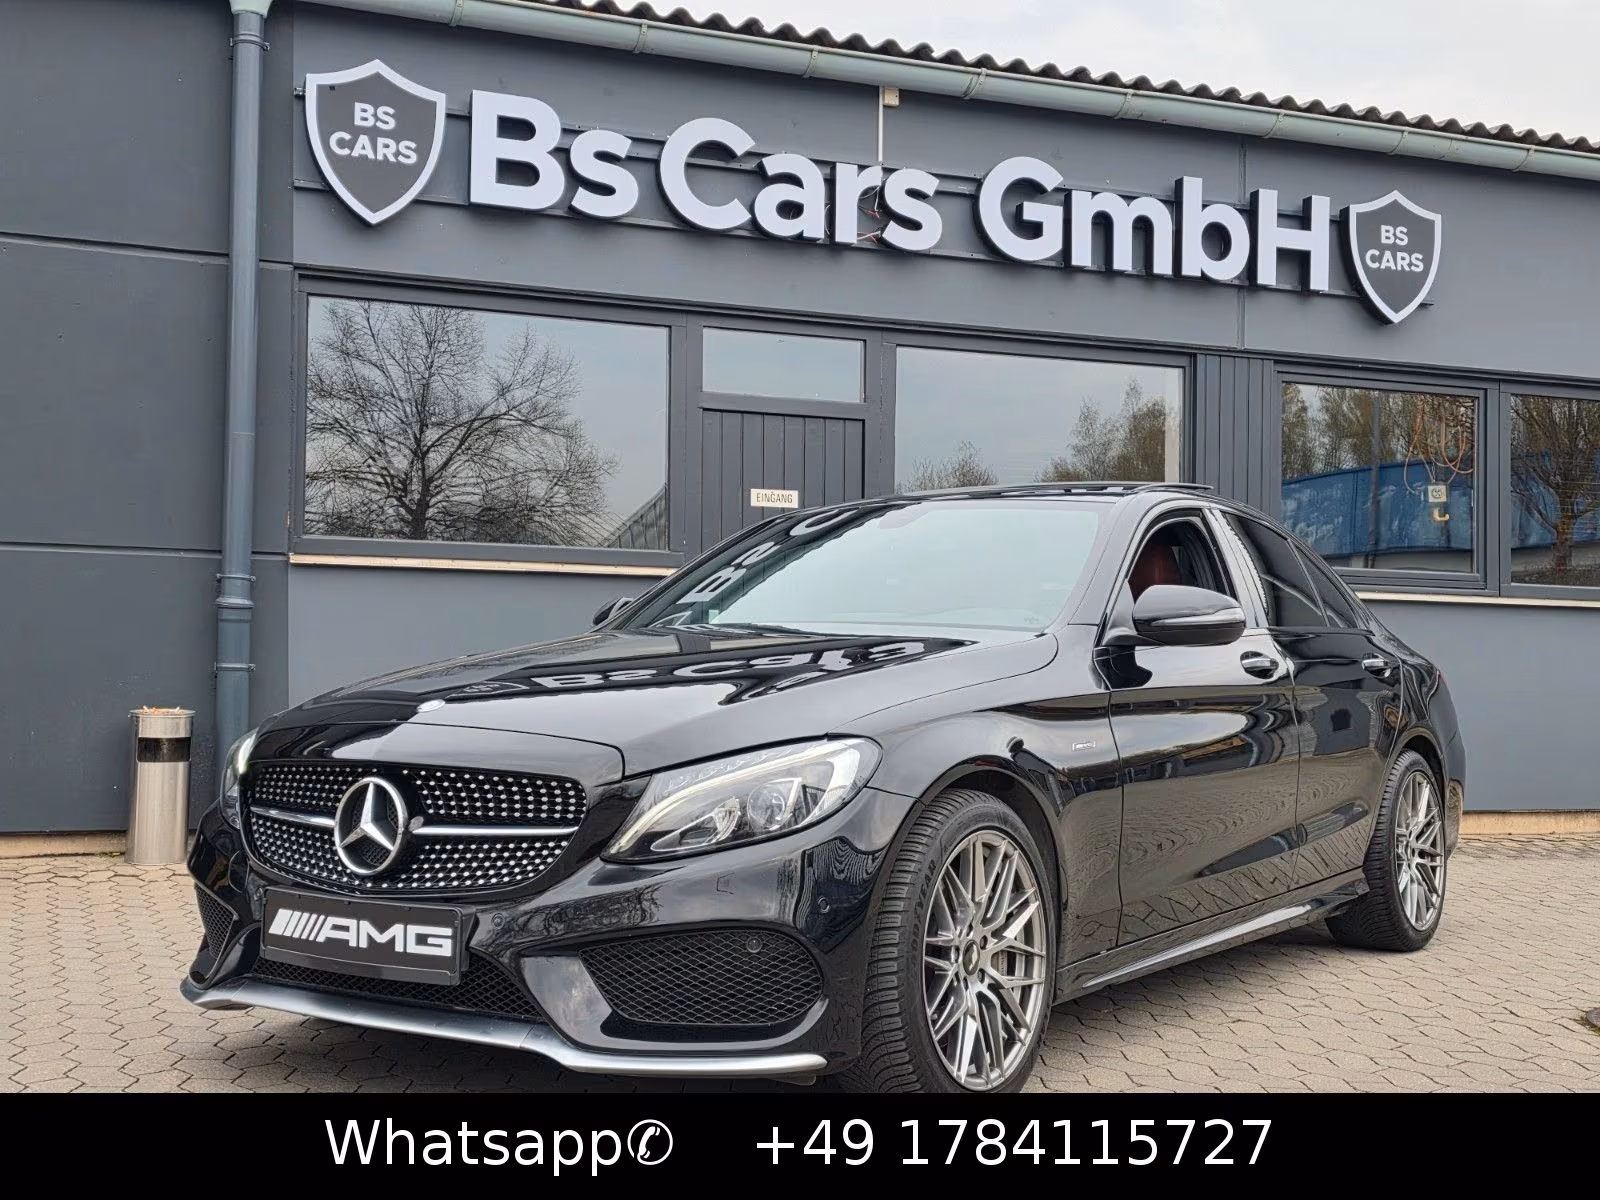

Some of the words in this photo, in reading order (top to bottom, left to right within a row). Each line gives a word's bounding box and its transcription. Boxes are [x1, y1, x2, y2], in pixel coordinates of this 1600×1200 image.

[353, 101, 396, 131] BS
[329, 131, 418, 165] CARS
[977, 156, 1332, 292] GmbH
[1380, 224, 1409, 246] BS
[1365, 248, 1424, 273] CARS
[756, 492, 793, 504] EINGANG
[316, 915, 453, 958] AMG
